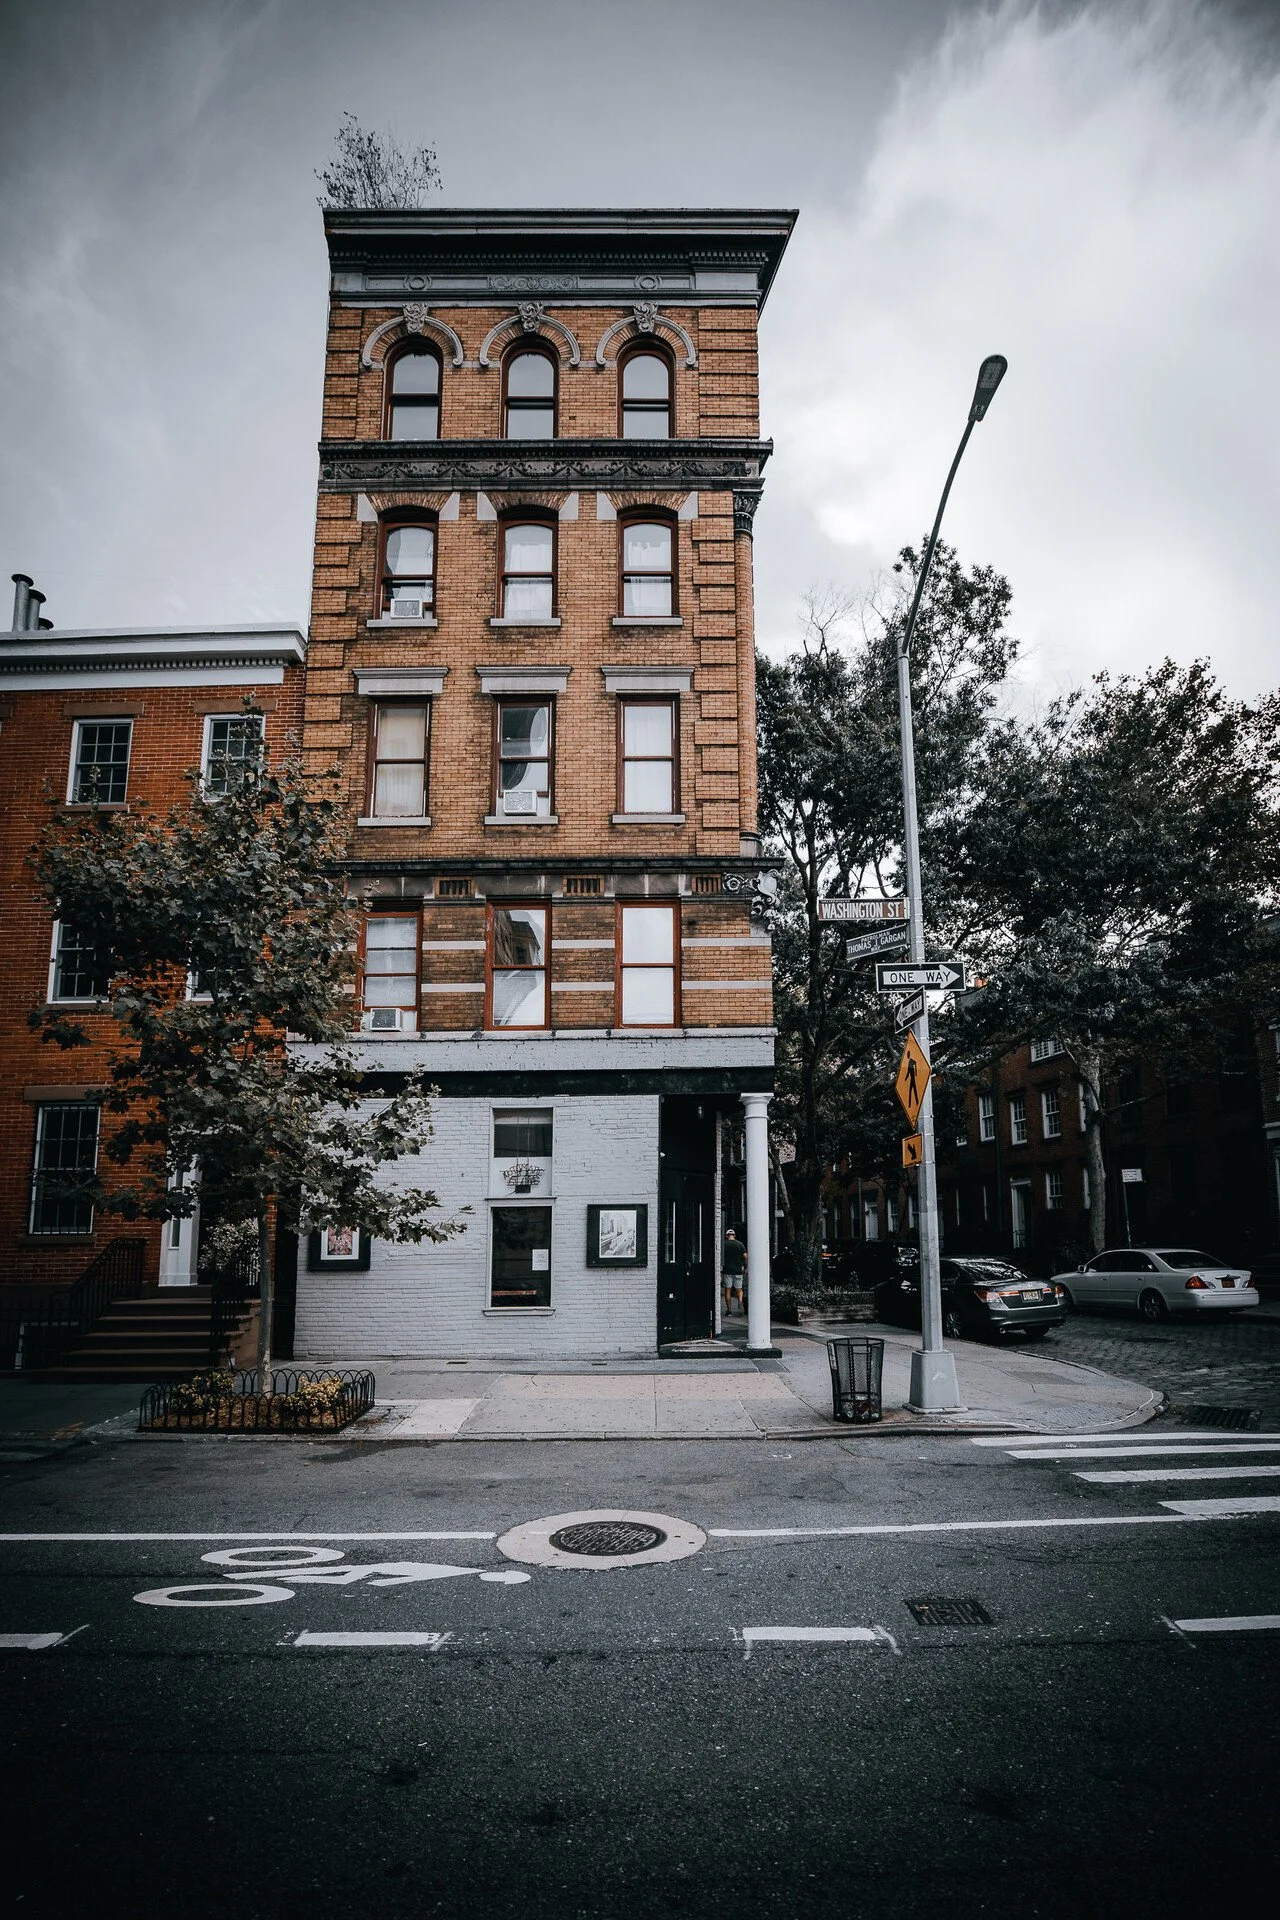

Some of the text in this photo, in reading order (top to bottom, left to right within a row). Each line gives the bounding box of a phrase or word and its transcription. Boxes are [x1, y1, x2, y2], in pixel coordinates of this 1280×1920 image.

[821, 902, 900, 918] WASHINGTON ST
[847, 940, 872, 954] THOMAS
[880, 931, 906, 945] GARGAN
[861, 931, 890, 943] PATROLMAN
[890, 971, 951, 983] ONE WAY
[899, 998, 921, 1021] ONE WAY
